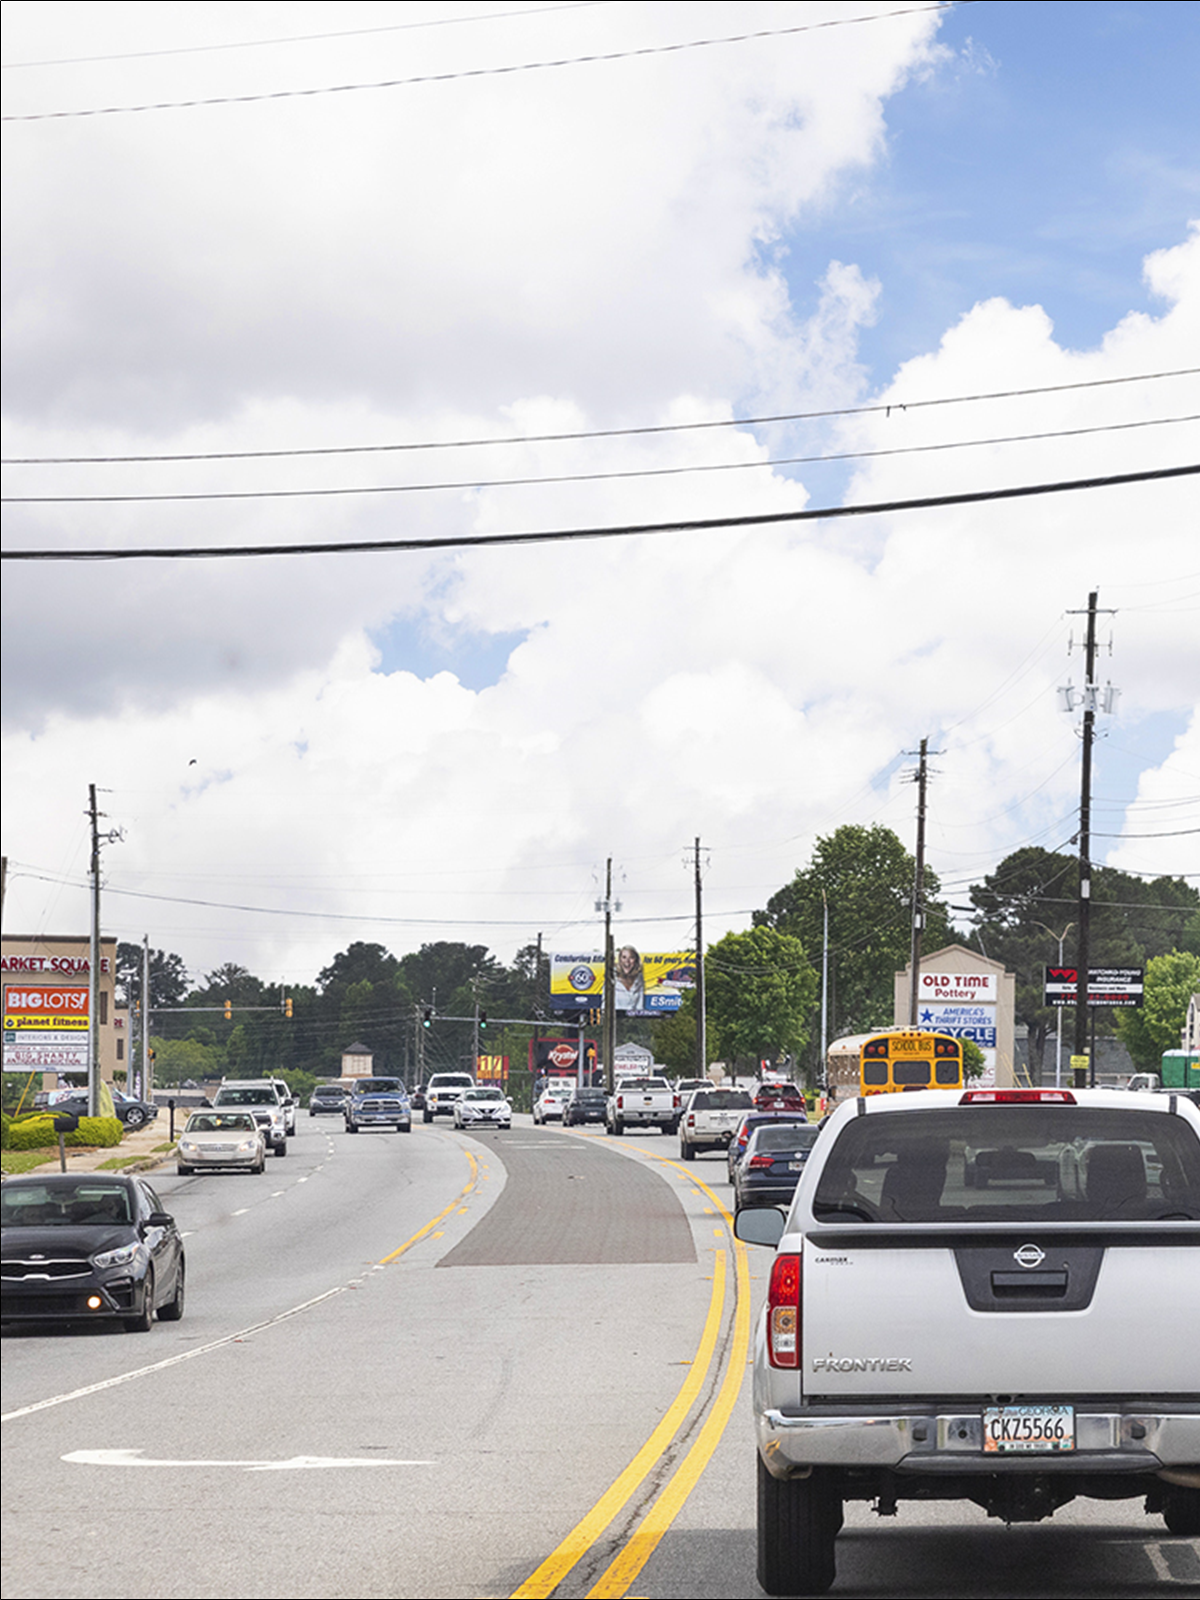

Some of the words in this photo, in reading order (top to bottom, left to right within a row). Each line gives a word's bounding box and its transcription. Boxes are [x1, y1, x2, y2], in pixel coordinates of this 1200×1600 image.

[1, 957, 45, 971] ARKET
[51, 957, 109, 976] SQUAE
[922, 975, 950, 987] OLD
[954, 976, 989, 988] TIME
[934, 988, 976, 999] Pottery
[8, 993, 42, 1007] BIG
[44, 993, 87, 1009] LOTS!
[943, 1007, 985, 1016] AMERICA'S
[17, 1018, 50, 1029] planet
[53, 1017, 88, 1026] fitness
[935, 1016, 961, 1024] THRIFT
[963, 1016, 992, 1025] STORES
[891, 1041, 917, 1051] SCHOOL
[918, 1041, 932, 1051] BUS
[548, 1051, 579, 1064] Krystal
[812, 1357, 912, 1373] FRONTIER
[1018, 1407, 1069, 1416] GEORGA
[990, 1417, 1064, 1441] CKZ5566
